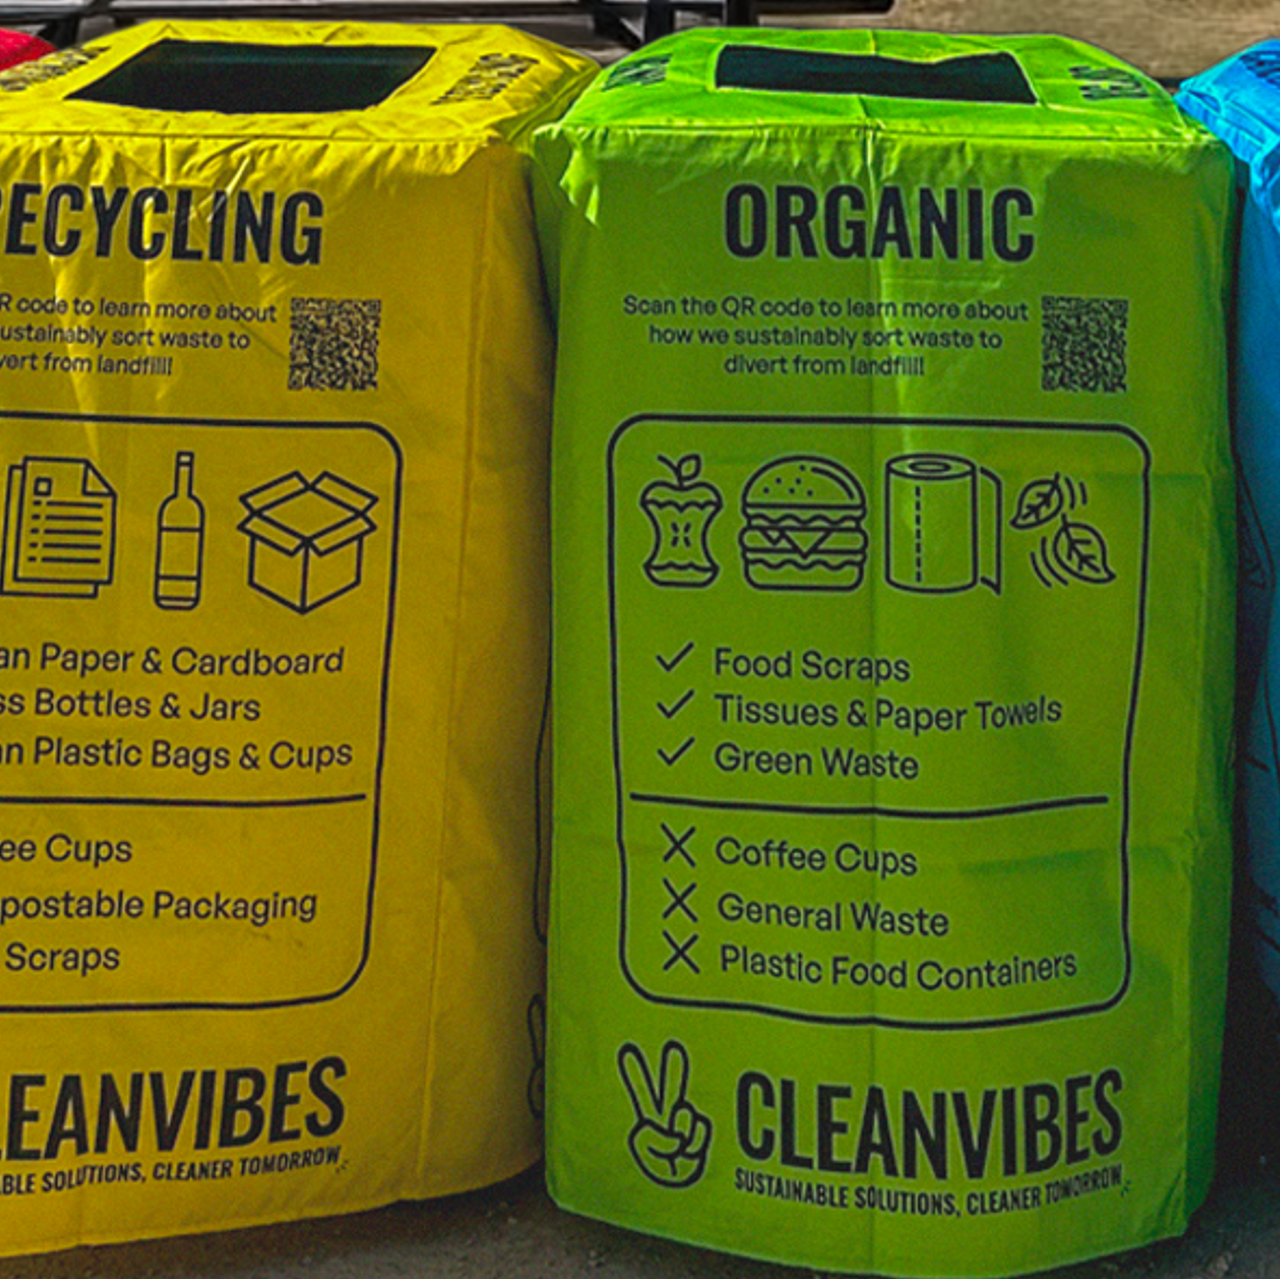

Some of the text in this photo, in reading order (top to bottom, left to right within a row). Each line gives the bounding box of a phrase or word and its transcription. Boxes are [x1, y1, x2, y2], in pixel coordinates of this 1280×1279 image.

[724, 183, 1035, 263] ORGANIC
[17, 294, 68, 315] code
[72, 297, 95, 316] to
[99, 298, 151, 317] learn
[155, 302, 211, 320] more
[215, 302, 277, 324] about
[624, 296, 1029, 322] Scan the QR code to learn more about
[111, 328, 155, 346] sort
[159, 331, 224, 350] waste
[228, 332, 250, 350] to
[649, 324, 1002, 350] how we sustainably sort waste to
[43, 353, 93, 373] from
[724, 355, 788, 375] divert
[793, 355, 845, 376] from
[40, 642, 135, 678] Paper
[141, 645, 162, 674] &
[172, 646, 344, 677] Cardboard
[715, 647, 910, 686] Food Scraps
[35, 687, 152, 719] Bottles
[159, 692, 180, 720] &
[190, 693, 261, 721] Jars
[715, 693, 1061, 736] Tissues & Paper Towels
[34, 735, 142, 768] Plastic
[152, 738, 230, 775] Bags
[239, 740, 261, 770] &
[269, 740, 353, 770] Cups
[714, 742, 918, 780] Green Waste
[46, 833, 133, 868] Cups
[716, 837, 917, 880] Coffee Cups
[154, 891, 317, 926] Packaging
[718, 893, 949, 937] General Waste
[5, 941, 120, 976] Scraps
[721, 944, 1076, 990] Plastic Food Containers
[736, 1067, 1123, 1181] CLEANVIBES
[41, 1162, 147, 1192] SOLUTIONS,
[153, 1157, 233, 1182] CLEANER
[239, 1145, 341, 1176] TOMORROW
[735, 1167, 848, 1208] SUSTAINABLE
[855, 1187, 961, 1218] SOLUTIONS,
[967, 1187, 1040, 1215] CLEANER
